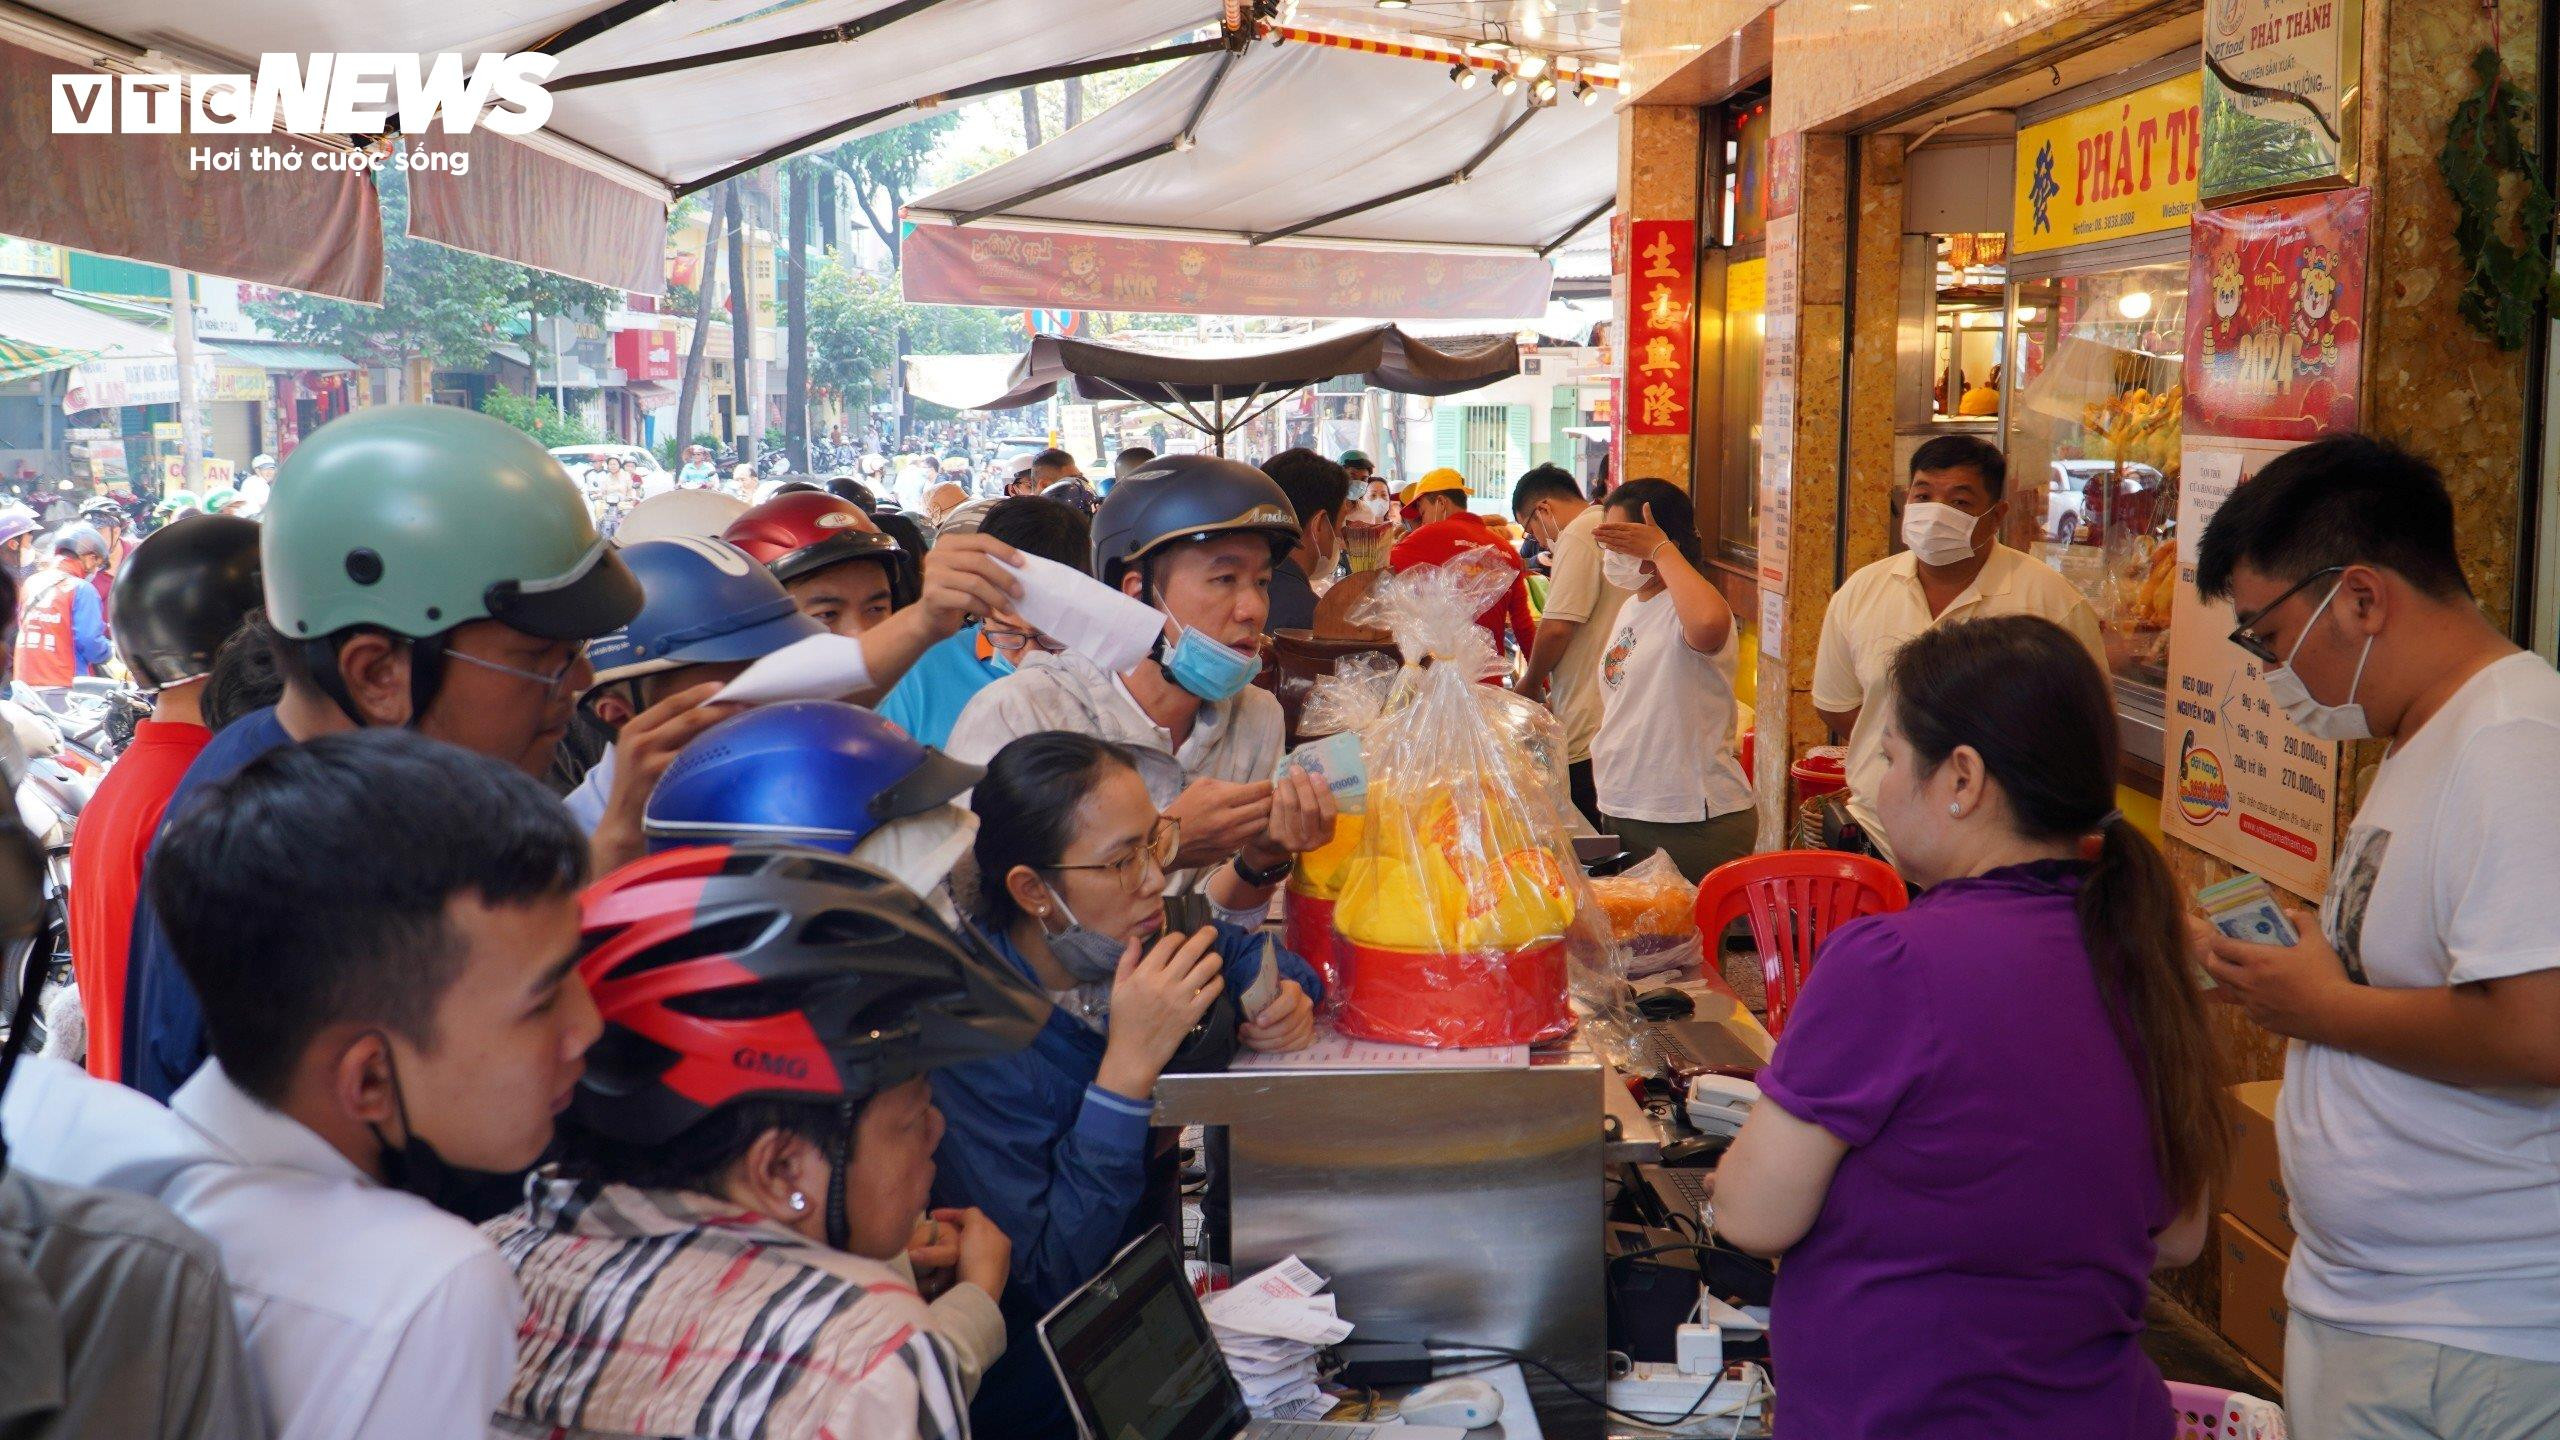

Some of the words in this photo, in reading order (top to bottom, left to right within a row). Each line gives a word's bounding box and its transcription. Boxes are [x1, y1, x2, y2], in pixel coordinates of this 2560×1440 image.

[2251, 14, 2282, 50] PHÁT
[2287, 2, 2332, 39] THÀNH
[2076, 104, 2158, 206] PHÁT
[2162, 200, 2190, 218] Website:
[2073, 223, 2095, 236] Hotline:
[2238, 332, 2297, 396] 2024
[1243, 506, 1295, 525] Andes
[2182, 674, 2195, 693] HEO
[2196, 679, 2214, 698] QUAY
[2203, 707, 2217, 726] CON
[732, 1047, 808, 1079] GMG
